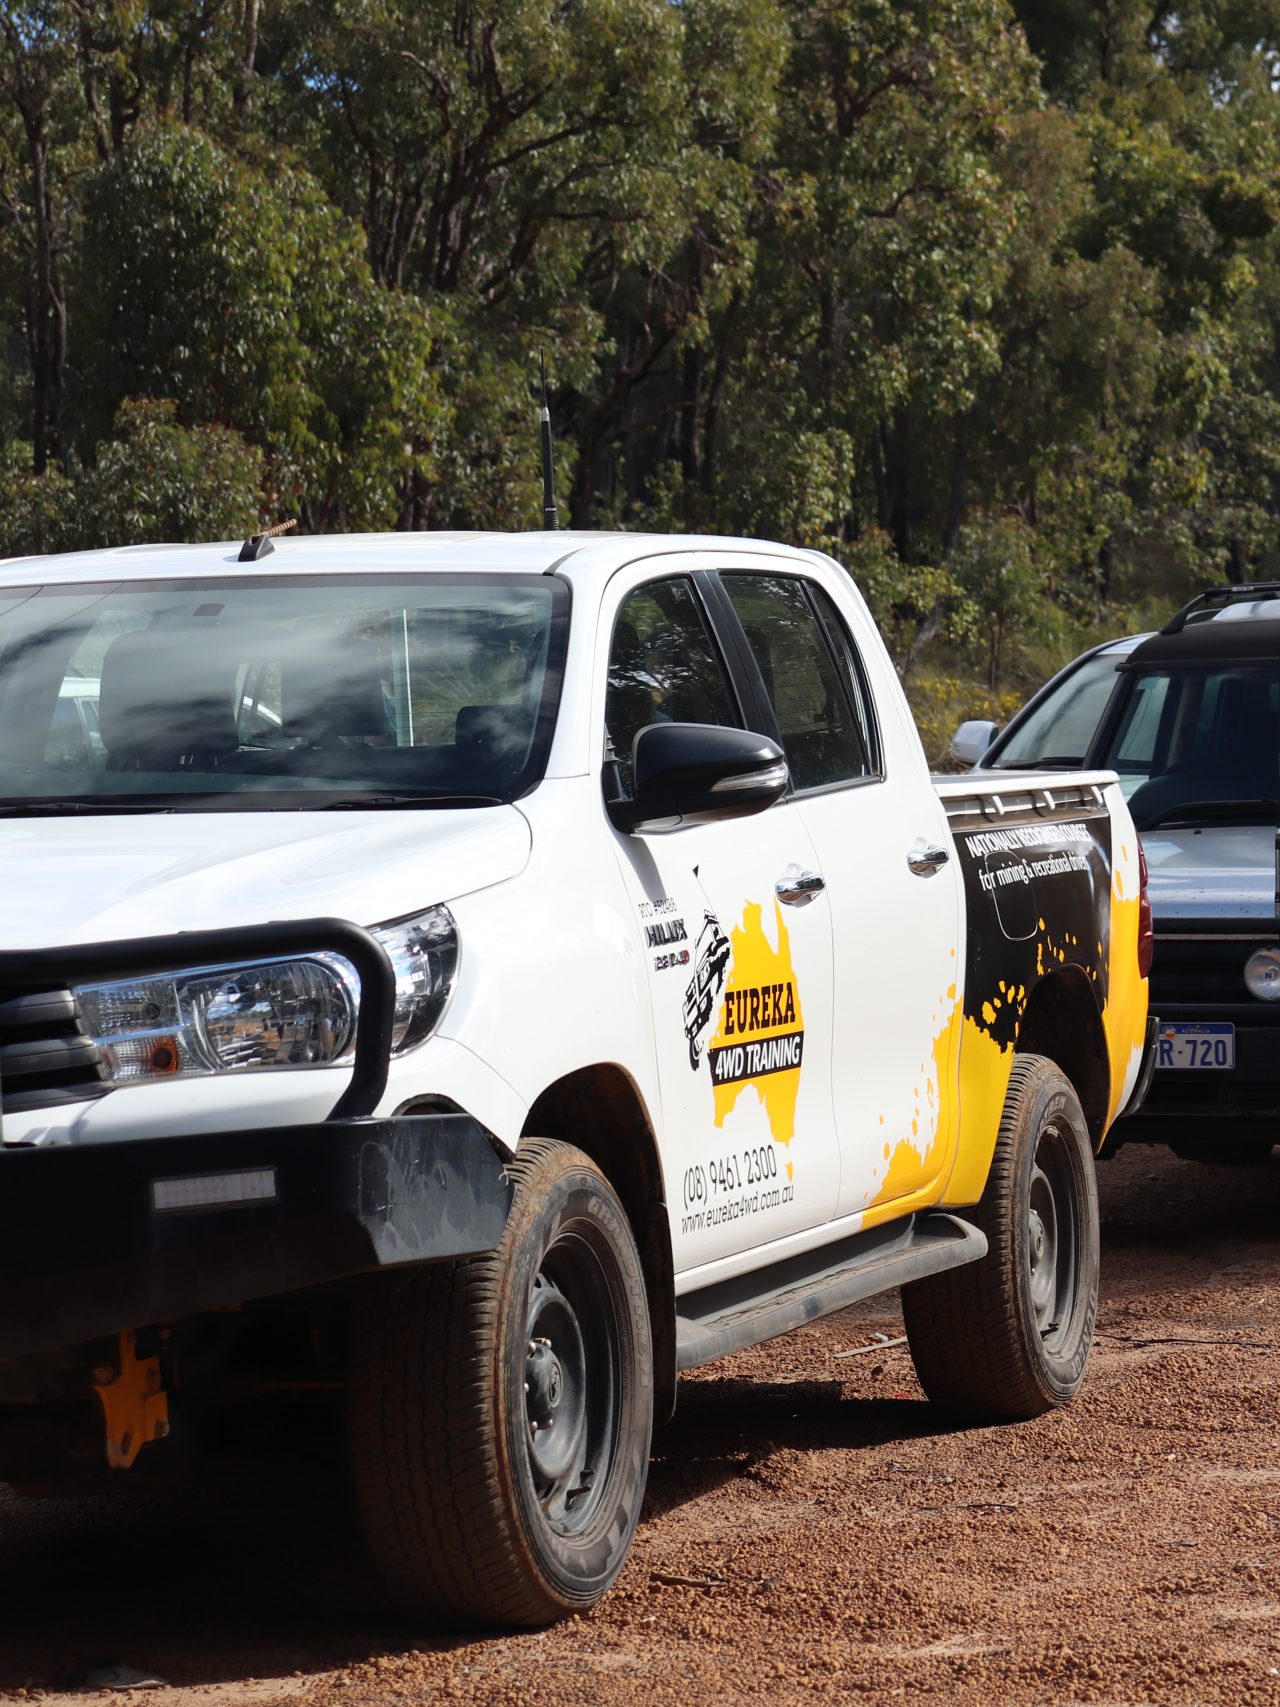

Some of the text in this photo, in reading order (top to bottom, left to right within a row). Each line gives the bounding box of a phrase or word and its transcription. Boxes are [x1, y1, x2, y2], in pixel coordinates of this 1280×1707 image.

[965, 829, 1023, 858] NATIONALLY
[978, 869, 997, 891] for
[996, 861, 1029, 885] mining
[1021, 858, 1033, 879] &
[1031, 851, 1073, 877] recreational
[644, 918, 688, 949] HILUX
[725, 982, 796, 1036] EUREKA
[715, 1036, 800, 1081] 4WD TRAINING
[683, 1144, 777, 1212] (08) 9461 2300
[681, 1184, 794, 1235] www.eureka4wd.com.au
